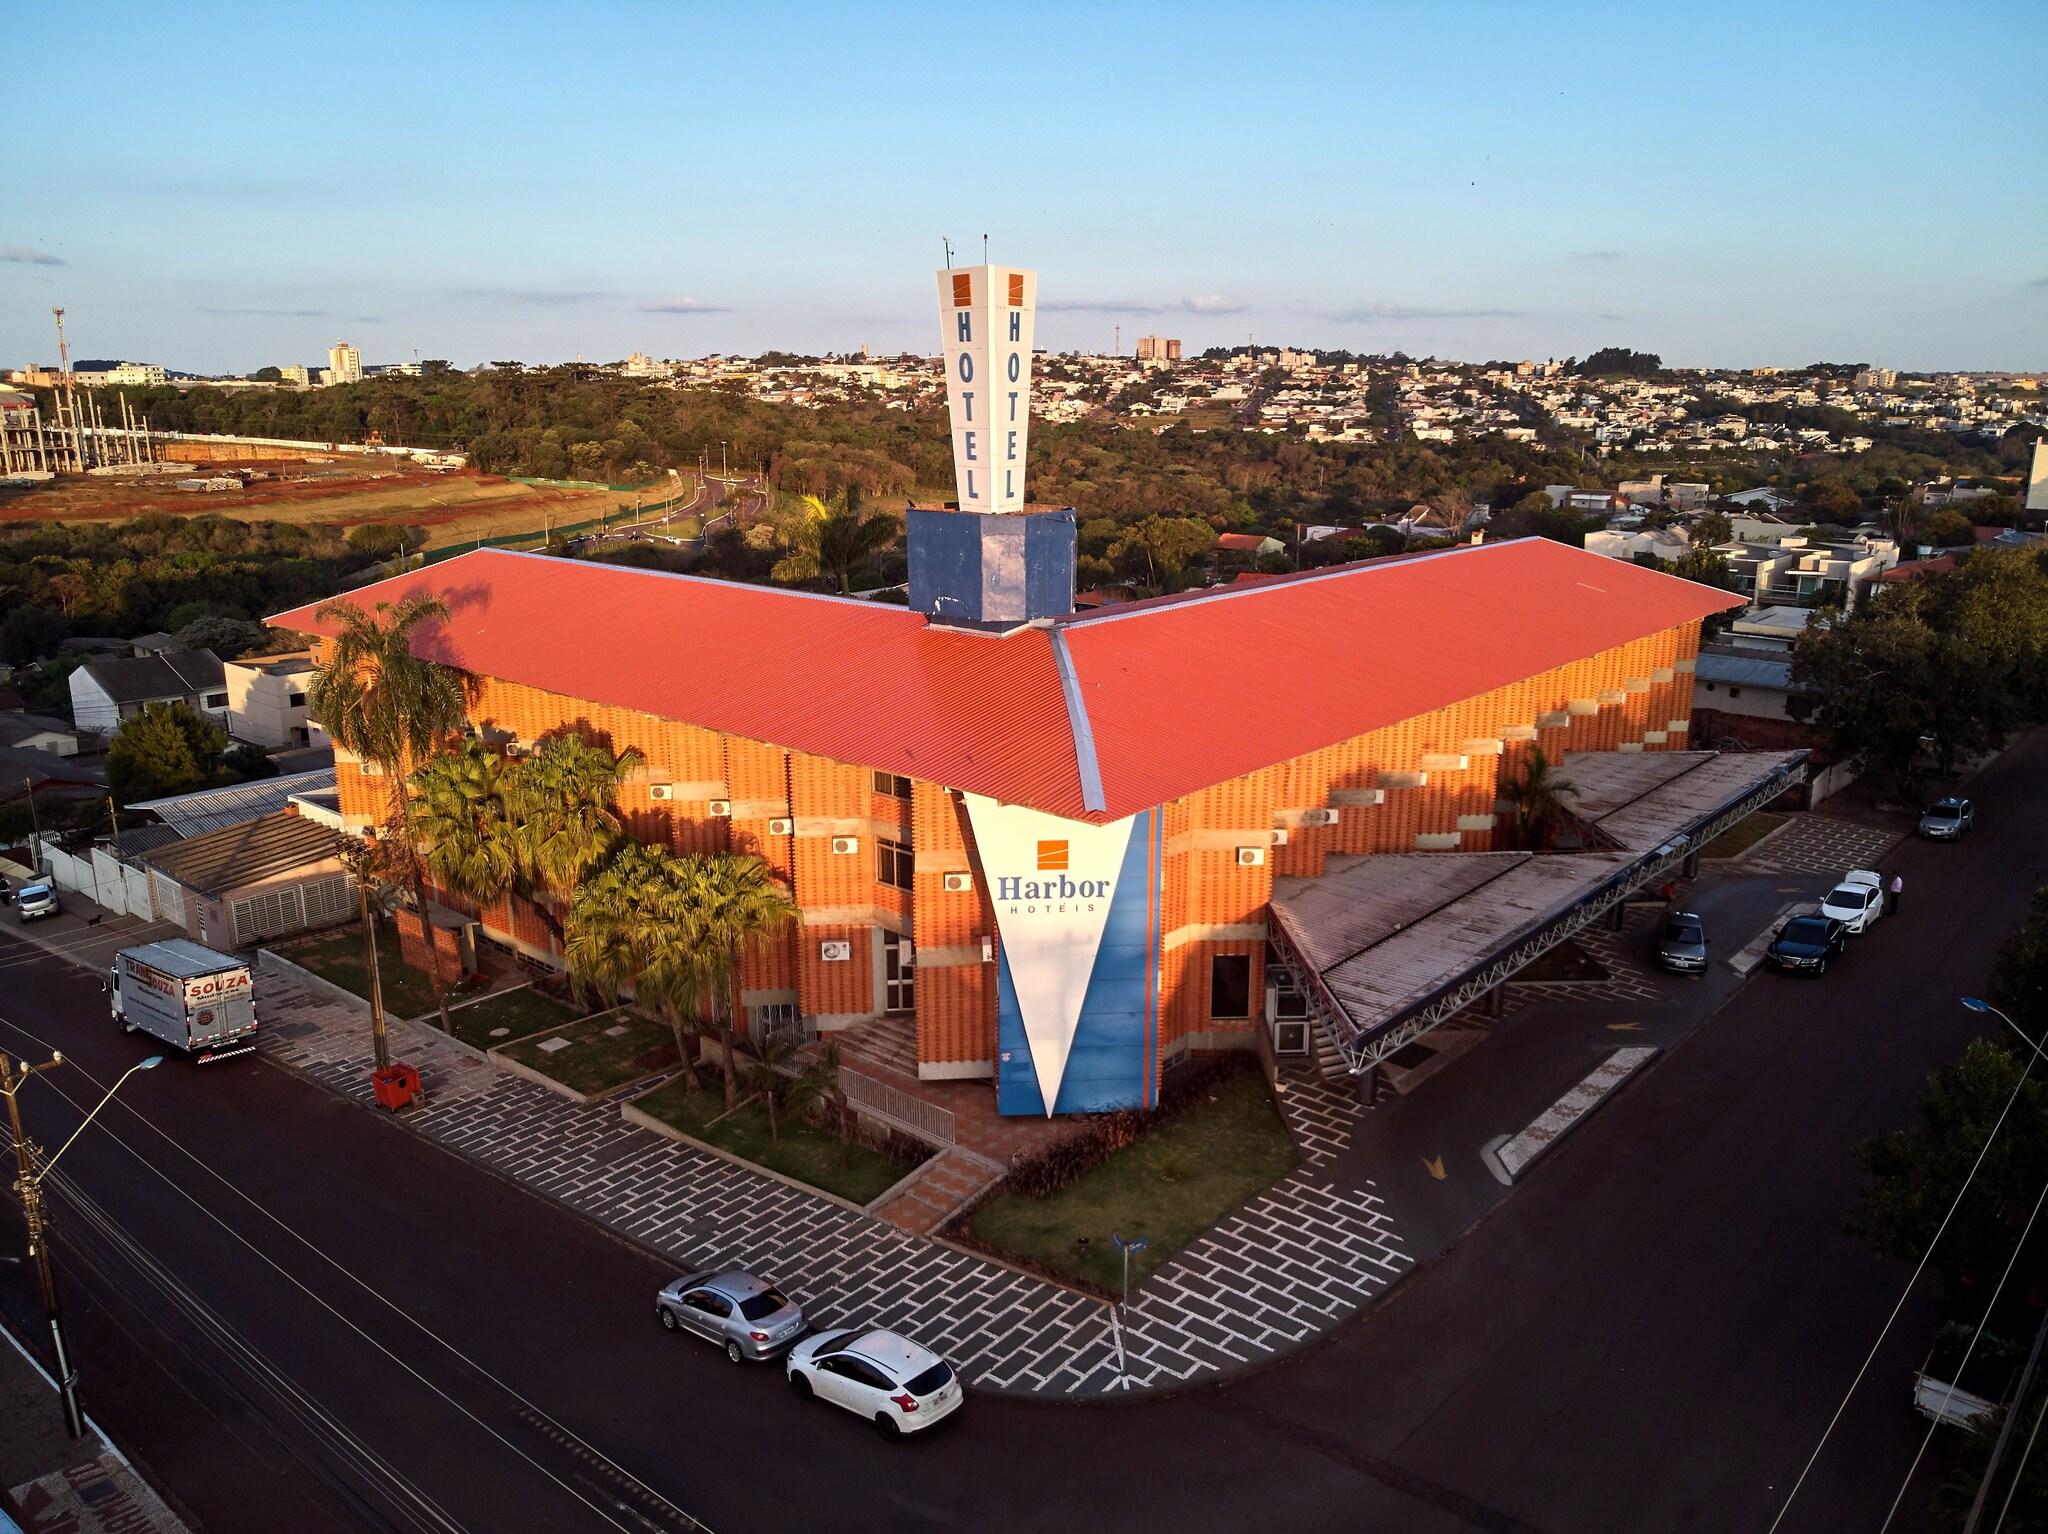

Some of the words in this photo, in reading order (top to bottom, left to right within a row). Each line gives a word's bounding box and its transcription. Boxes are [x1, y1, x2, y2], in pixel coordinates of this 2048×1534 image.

[957, 311, 979, 499] HOTEL
[1006, 311, 1020, 498] HOTEL
[997, 874, 1110, 901] Harbor
[1010, 903, 1095, 914] HOTÉIS
[190, 975, 248, 997] SOUZA
